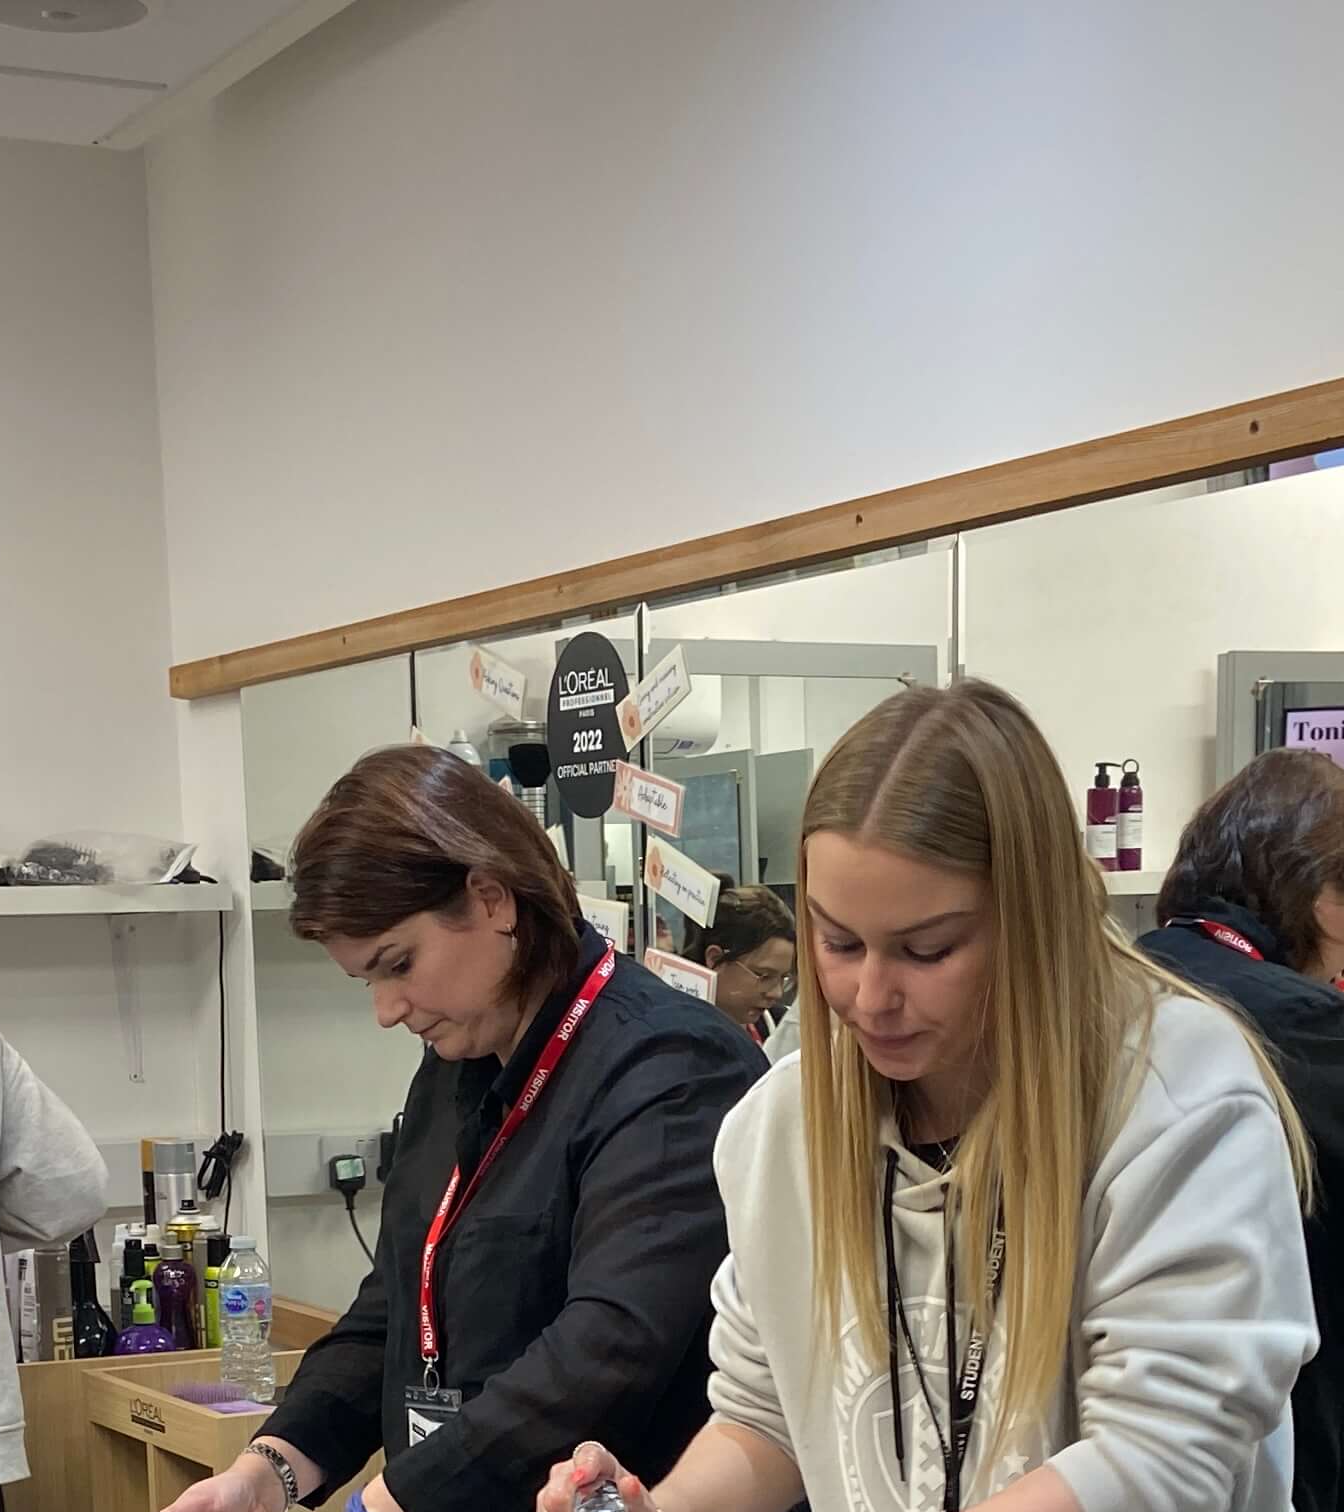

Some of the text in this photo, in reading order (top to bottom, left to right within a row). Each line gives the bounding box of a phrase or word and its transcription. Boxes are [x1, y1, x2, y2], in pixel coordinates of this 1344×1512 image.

[558, 667, 614, 695] L'ORÉAL
[573, 729, 603, 753] 2022
[557, 760, 616, 779] OFFICIAL PARTNE
[558, 998, 589, 1041] VISITOR
[520, 1068, 549, 1112] VISITOR
[420, 1304, 435, 1350] VISITOR
[960, 1331, 984, 1401] STUDENT
